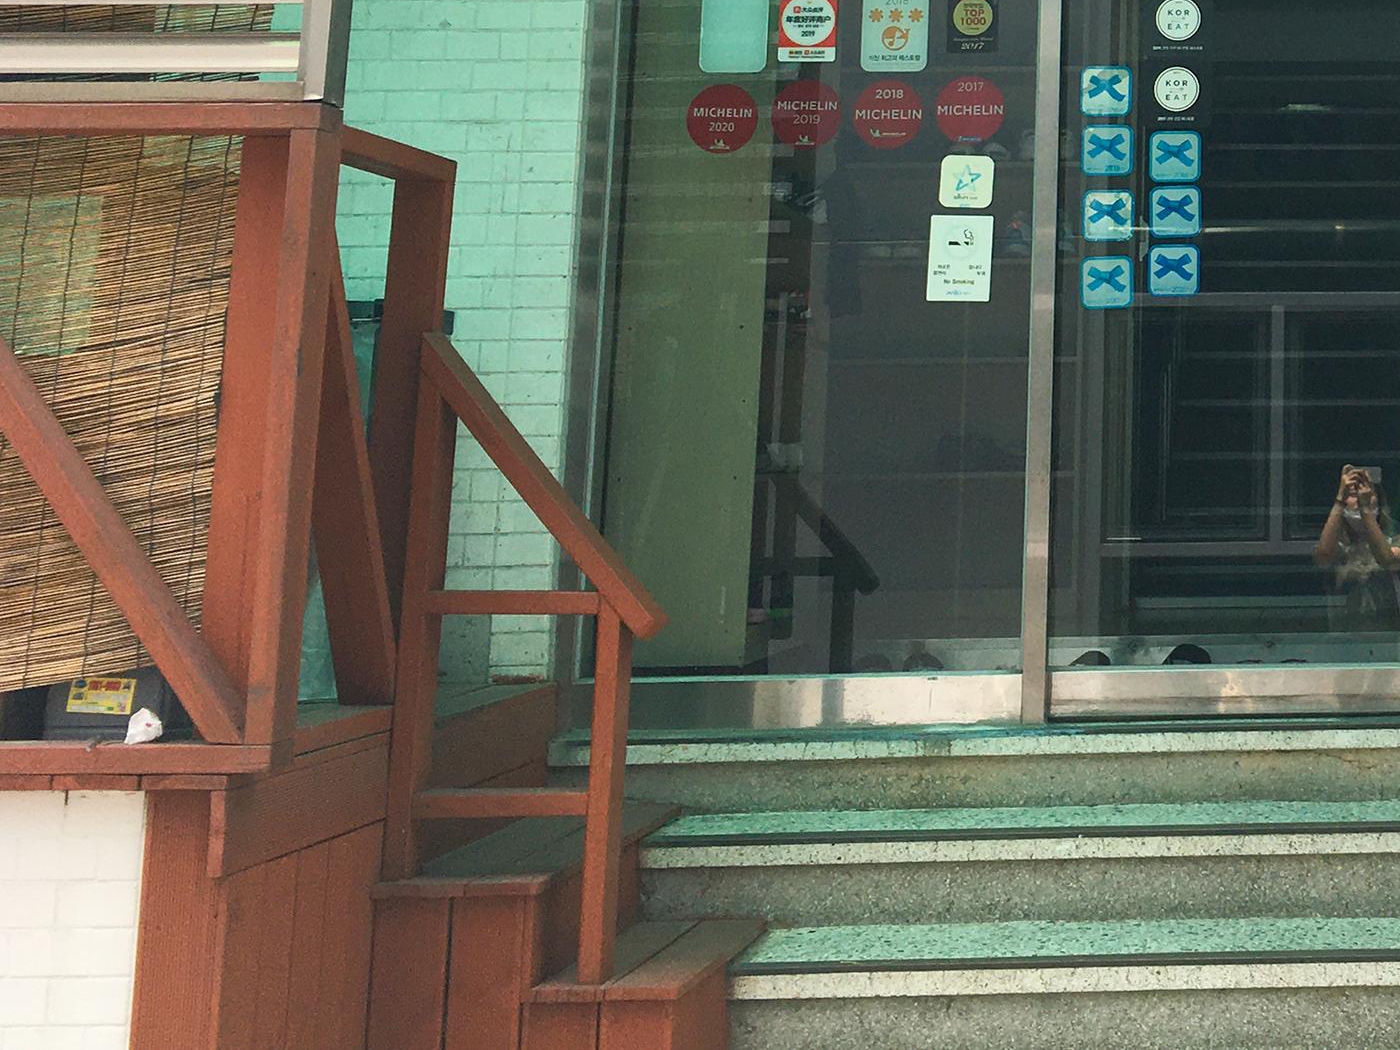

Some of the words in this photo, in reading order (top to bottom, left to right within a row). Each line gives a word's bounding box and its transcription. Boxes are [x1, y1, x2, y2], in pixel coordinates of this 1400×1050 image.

[963, 9, 985, 17] TOP
[960, 17, 987, 26] 1000
[956, 81, 985, 92] 2017
[874, 88, 904, 99] 2018
[776, 100, 838, 111] MICHELIN
[937, 105, 1004, 115] MICHELIN
[693, 107, 752, 118] MICHELIN
[855, 109, 923, 120] MICHELIN
[793, 114, 821, 125] 2019
[708, 121, 735, 132] 2020
